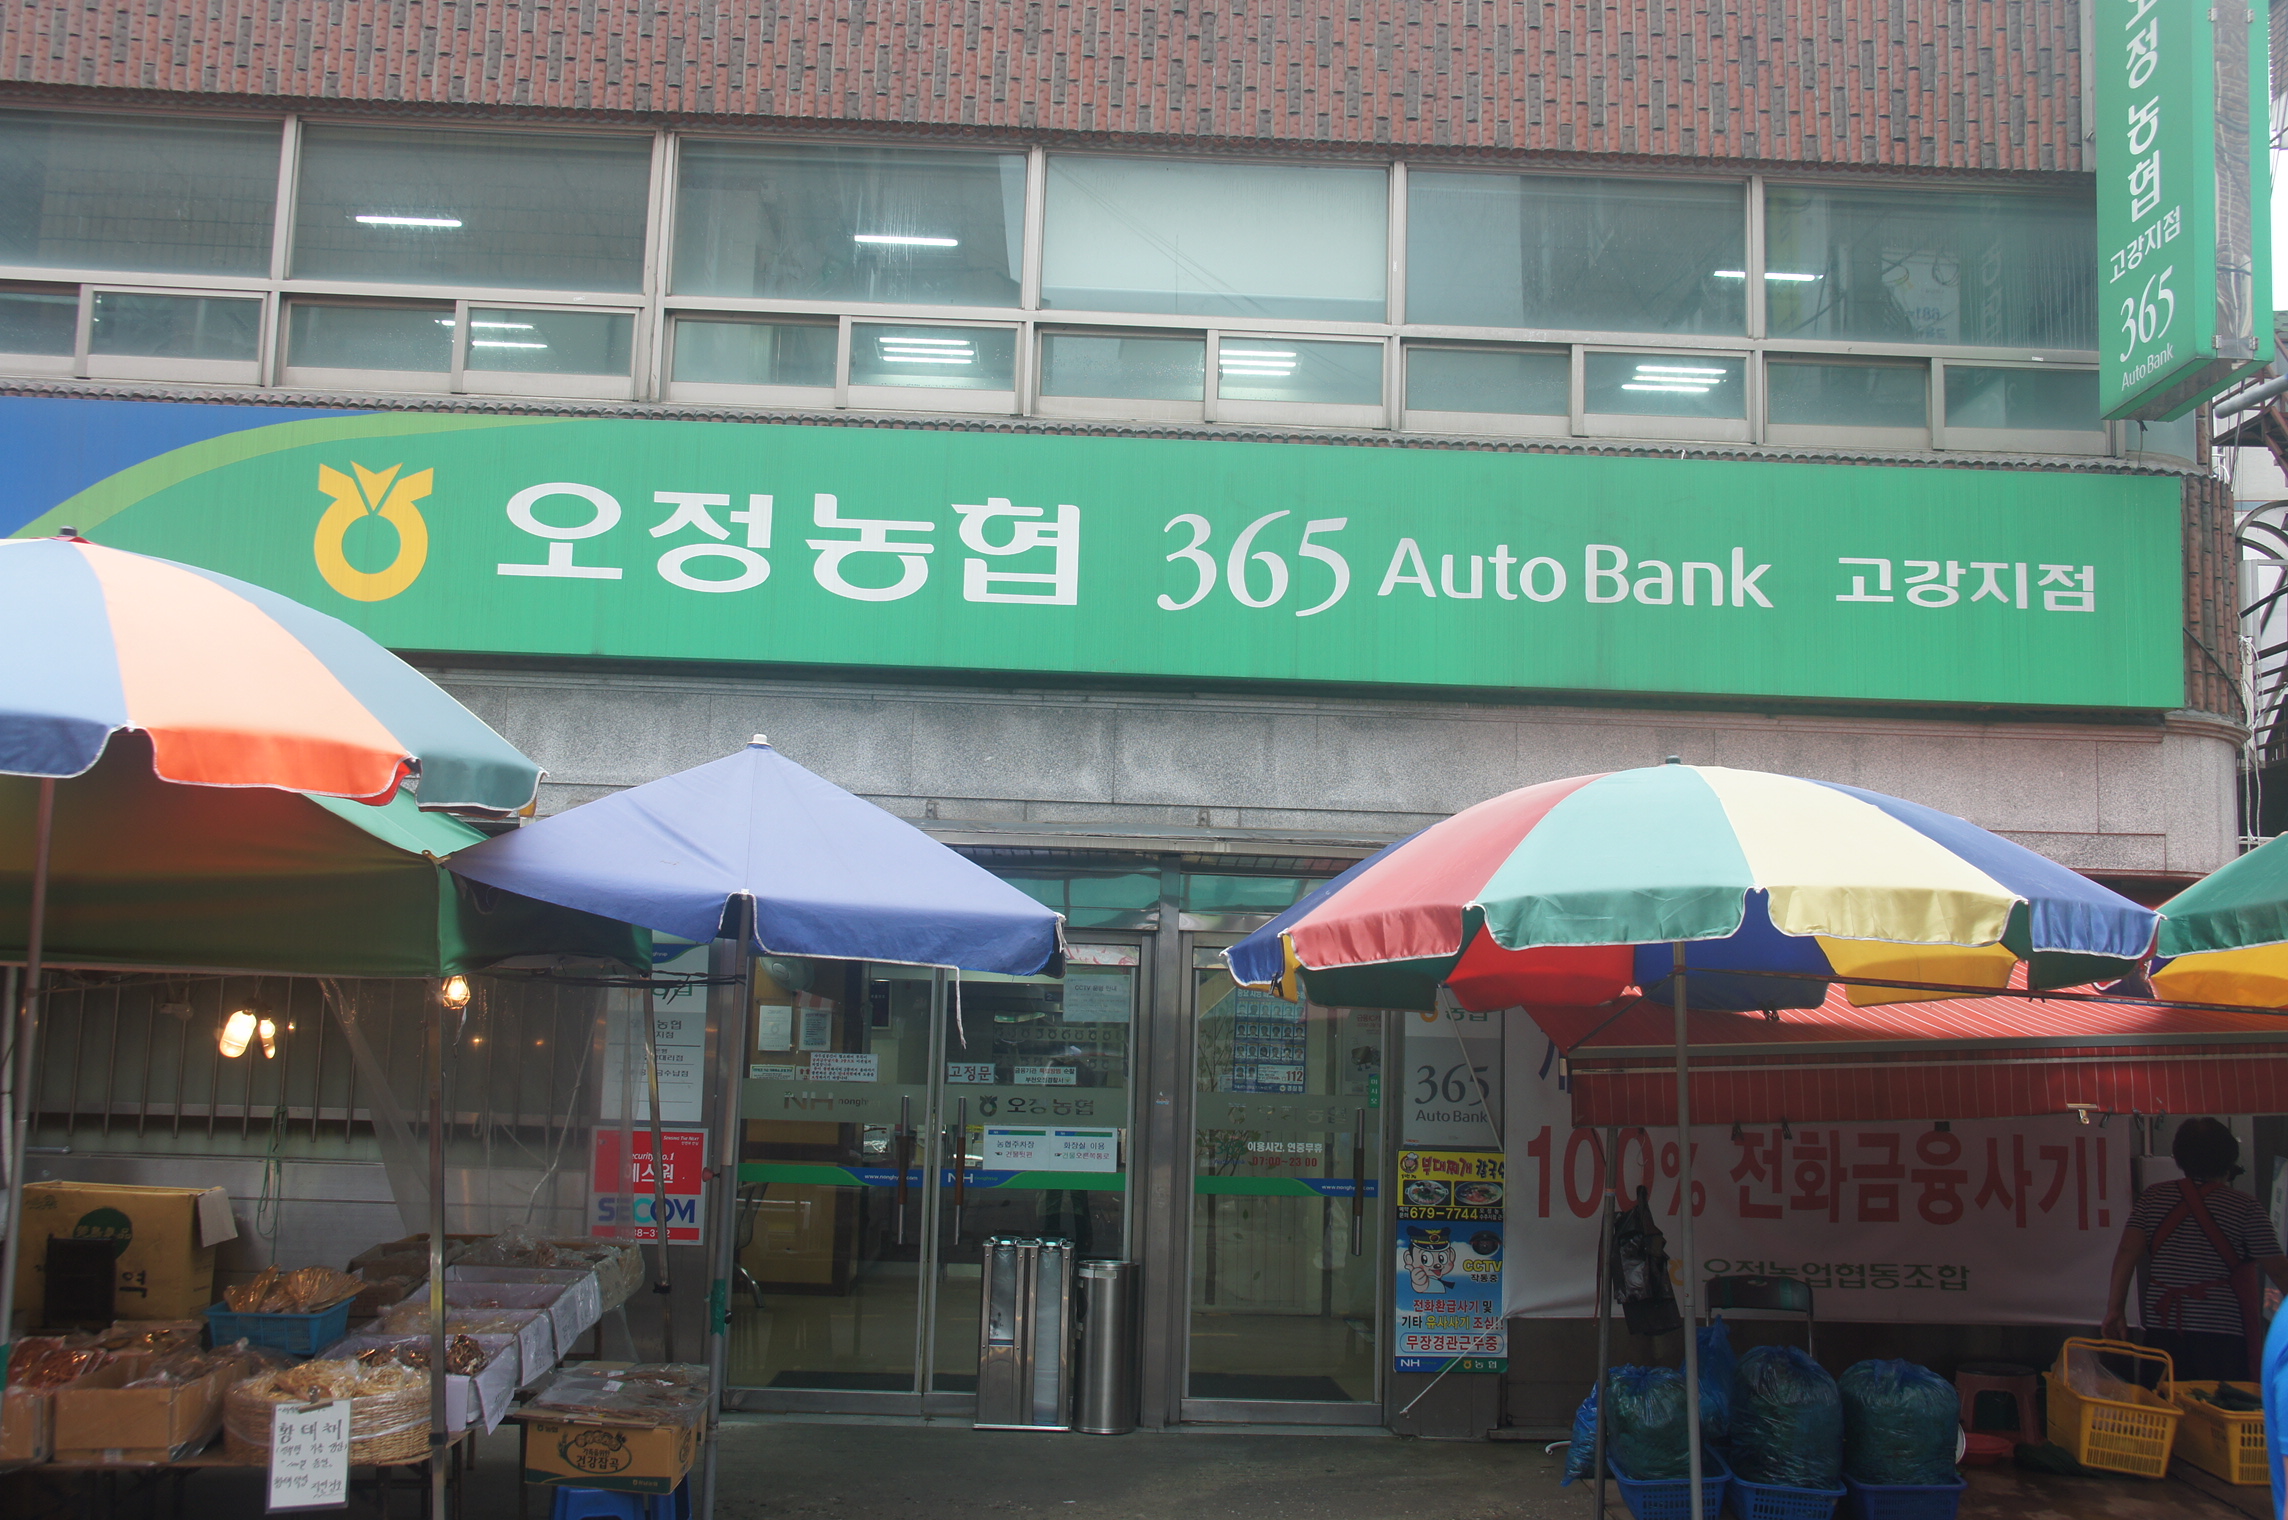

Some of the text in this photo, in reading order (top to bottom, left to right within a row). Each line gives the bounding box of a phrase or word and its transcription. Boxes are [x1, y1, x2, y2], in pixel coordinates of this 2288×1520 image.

[2109, 204, 2181, 284] 고강지점
[2119, 264, 2175, 363] 365
[2121, 342, 2175, 392] Auto Bank
[497, 482, 1080, 606] 오정농협
[1156, 509, 1775, 617] 365 Auto Bank
[1835, 557, 2095, 613] 고강지점
[948, 1065, 992, 1082] 고정문
[1286, 1070, 1304, 1082] 112
[1414, 1063, 1490, 1107] 365
[1006, 1096, 1094, 1116] 오정농협
[1415, 1109, 1488, 1123] Auto Bank
[1063, 1141, 1086, 1150] 화장실
[1287, 1142, 1323, 1154] 연중무휴
[662, 1152, 675, 1161] o.1
[1421, 1156, 1473, 1177] 부대찌개
[1527, 1125, 2111, 1231] 100% 전화금융사기!
[598, 1197, 696, 1224] SECOM
[1409, 1206, 1479, 1220] 679-7744
[1462, 1258, 1504, 1273] CCTV
[1470, 1274, 1499, 1283] 작동중
[1413, 1299, 1493, 1314] 전화환급사기 및
[1401, 1315, 1504, 1331] 기타 유사사기 조심!!
[1406, 1334, 1498, 1352] 무장경관근무중
[1400, 1358, 1421, 1367] NH
[1475, 1360, 1498, 1369] 농협
[278, 1418, 342, 1444] 황태채
[575, 1454, 619, 1471] 건강잡곡
